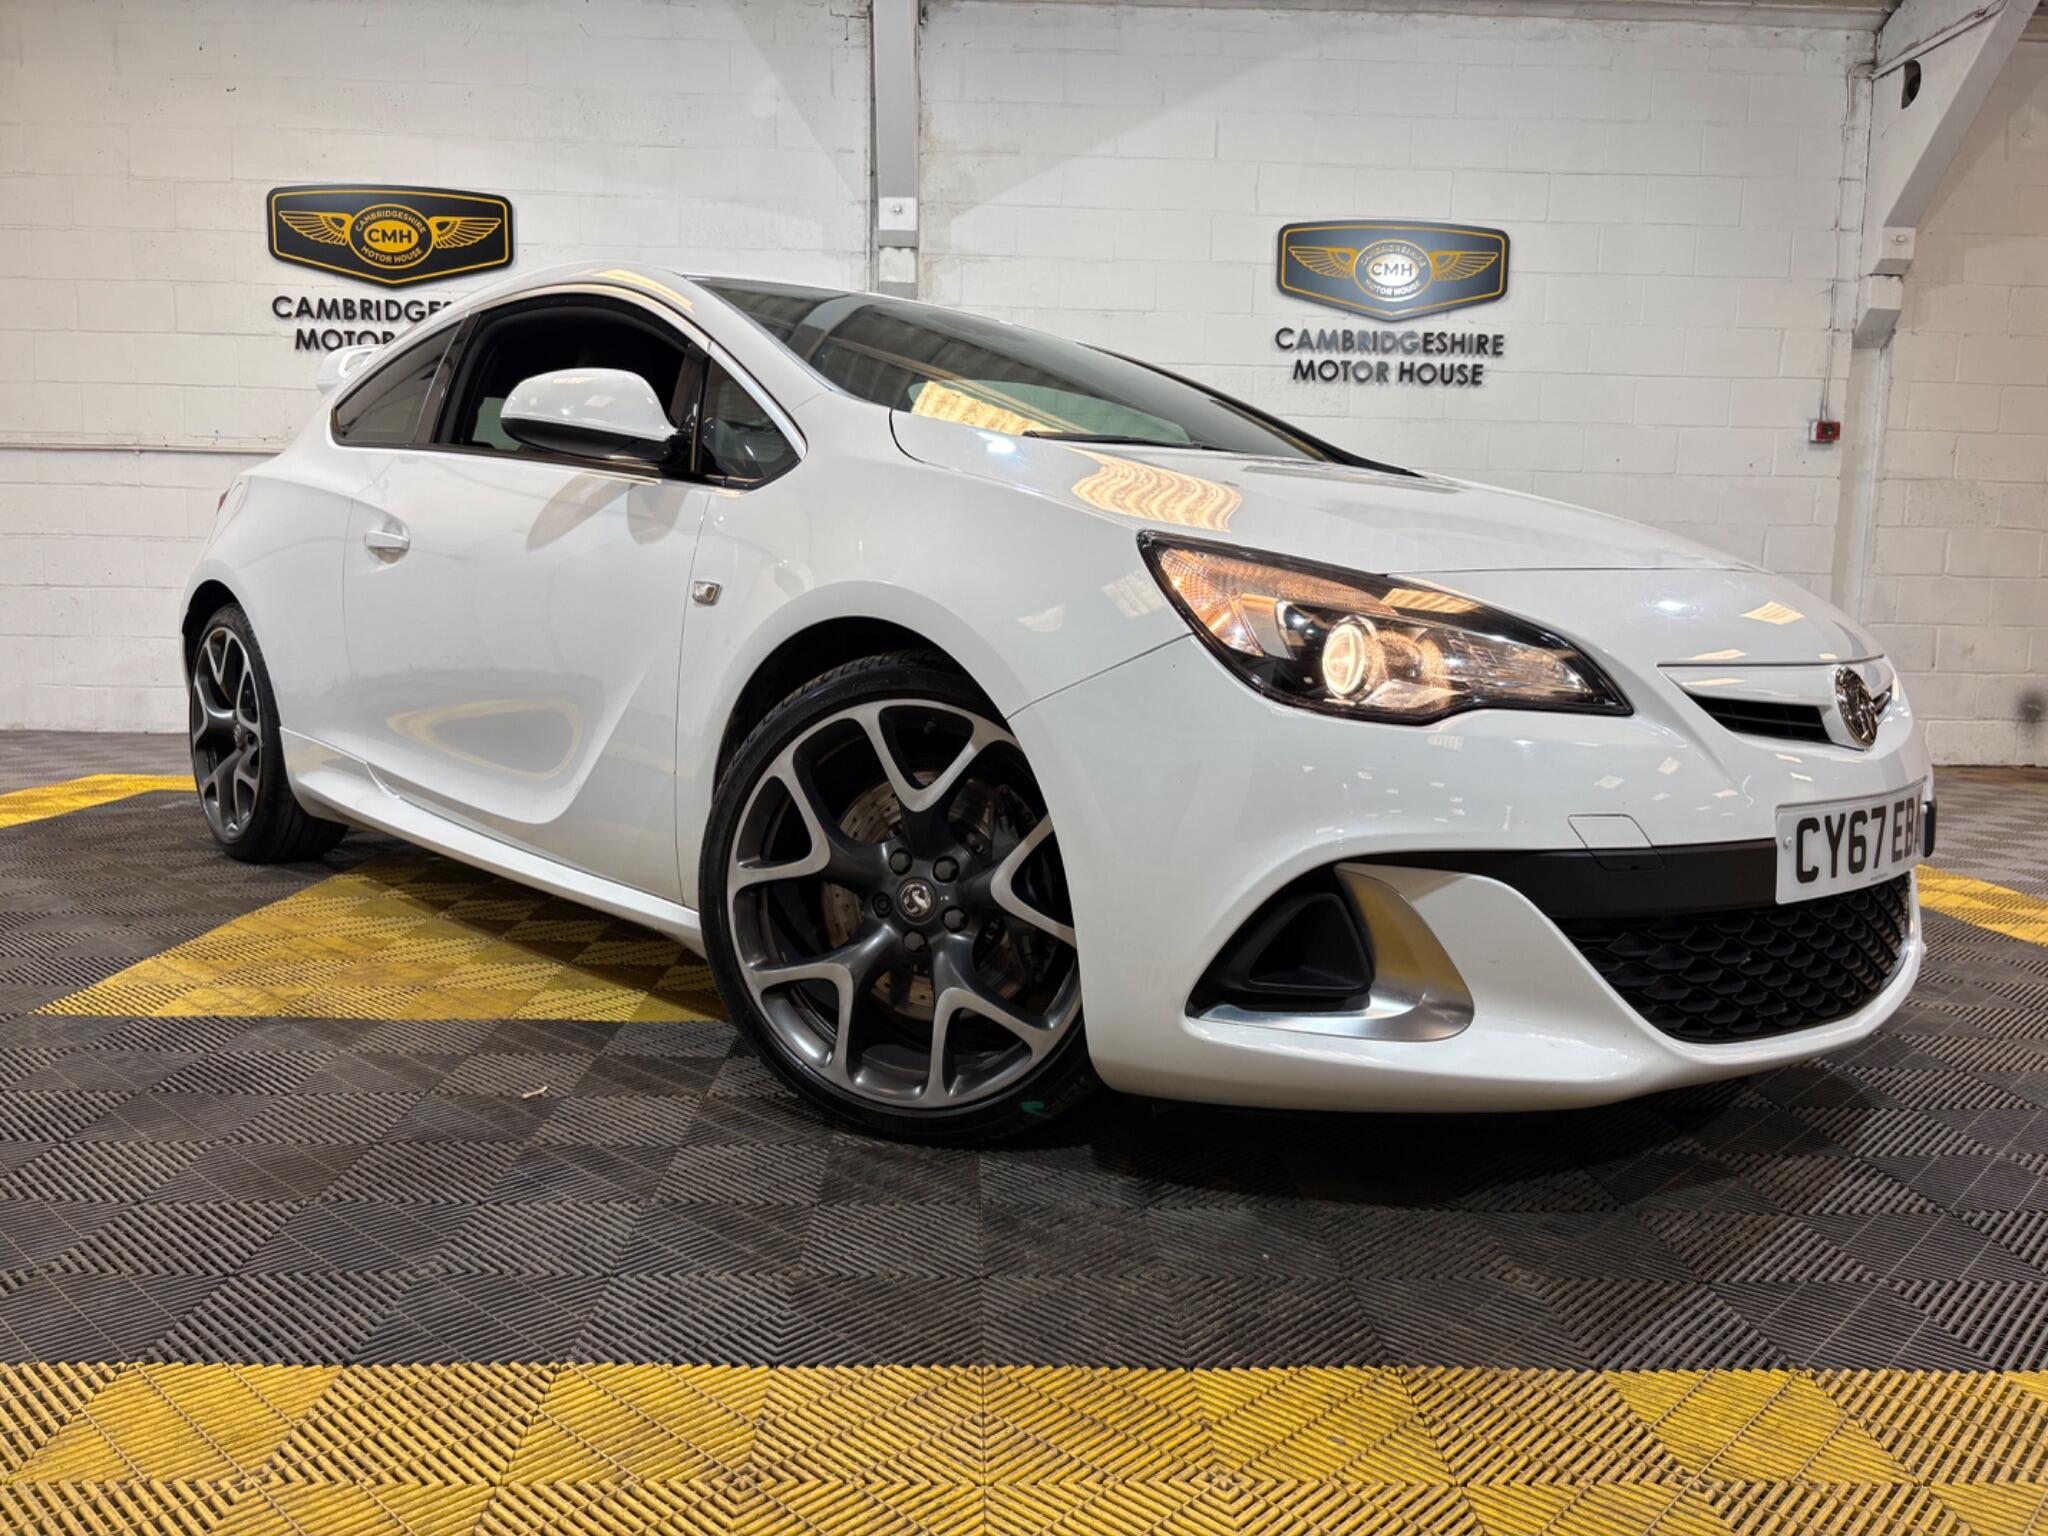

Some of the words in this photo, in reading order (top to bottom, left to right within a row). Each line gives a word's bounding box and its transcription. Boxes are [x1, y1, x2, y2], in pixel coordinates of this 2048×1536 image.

[355, 210, 426, 234] CAMBRIDGESHIRE
[368, 228, 412, 244] CMH
[361, 245, 393, 263] MOTOR
[394, 246, 423, 263] HOUSE
[1371, 262, 1413, 277] CMH
[272, 296, 453, 322] CAMBRIDGE
[1275, 327, 1505, 356] CAMBRIDGESHIRE
[1293, 359, 1390, 383] MOTOR
[1398, 361, 1484, 385] HOUSE
[1796, 805, 1887, 884] CY67
